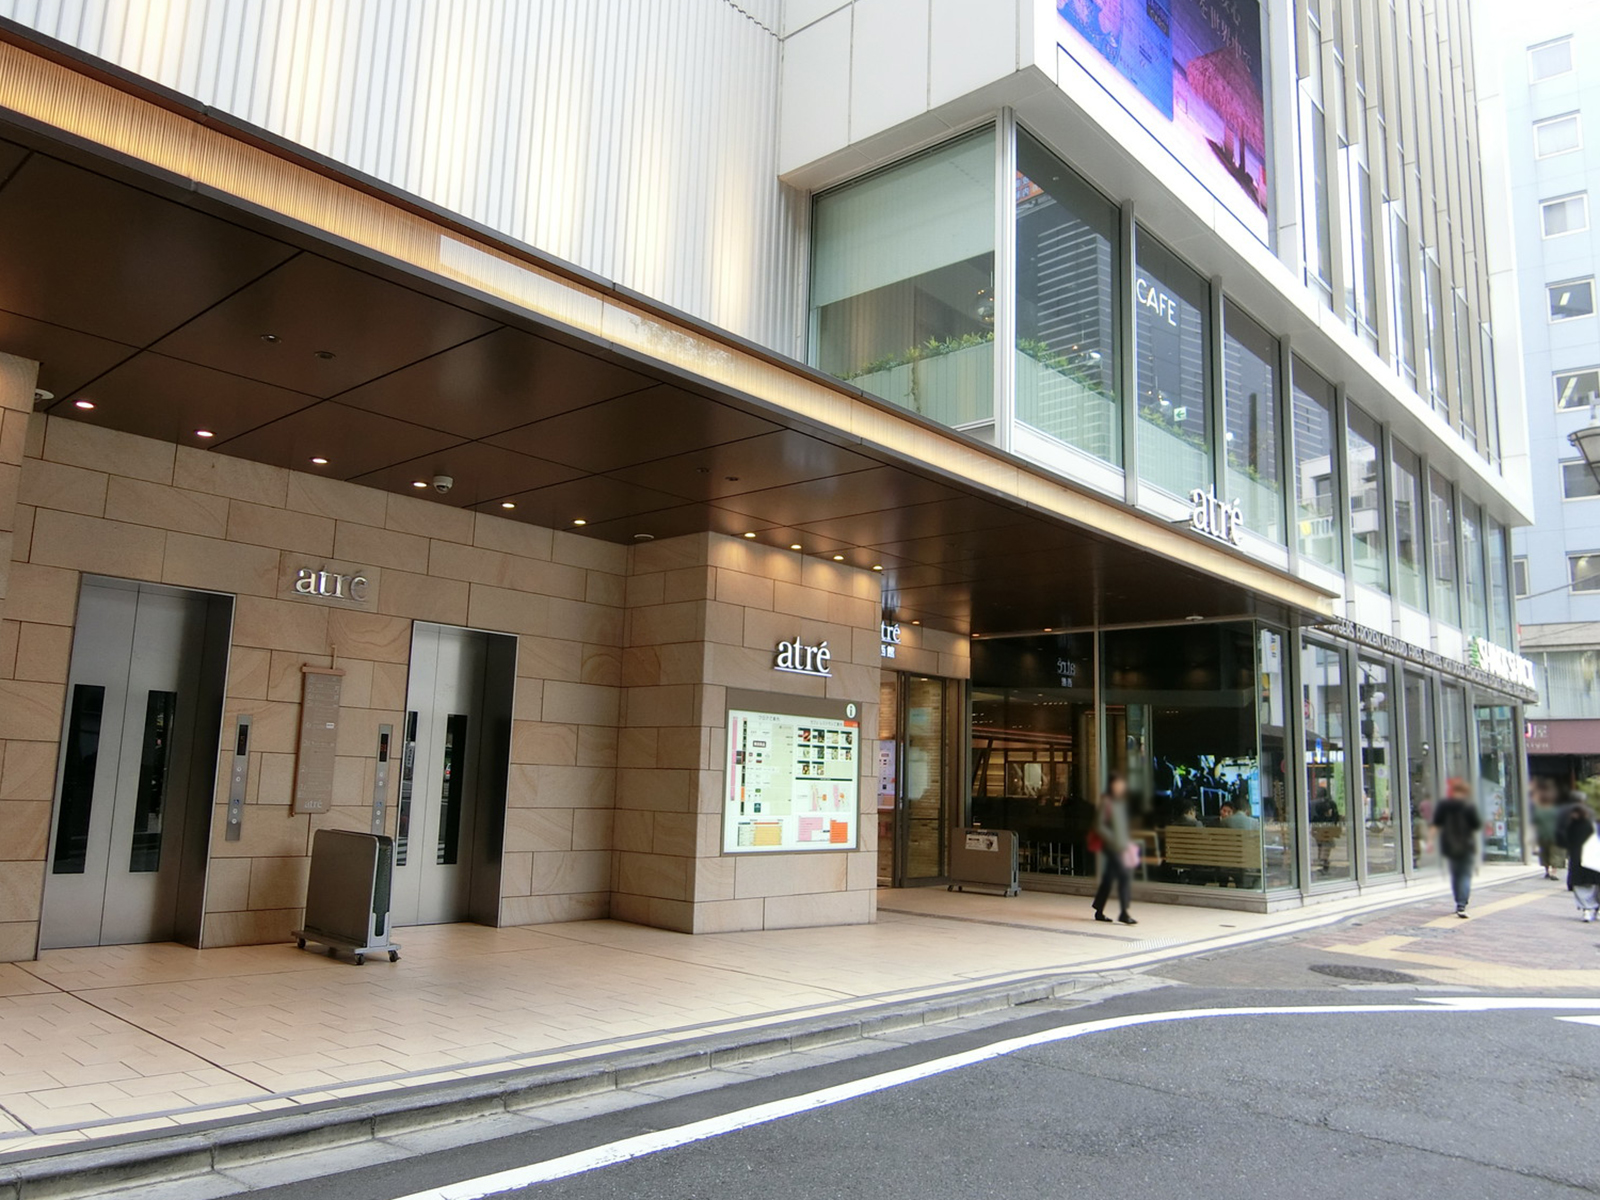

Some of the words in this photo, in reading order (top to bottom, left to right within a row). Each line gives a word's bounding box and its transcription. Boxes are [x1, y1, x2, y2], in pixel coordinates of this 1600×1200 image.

[1136, 277, 1177, 327] CAFE
[1191, 484, 1244, 546] atré
[881, 621, 902, 642] tré
[776, 636, 832, 674] atré
